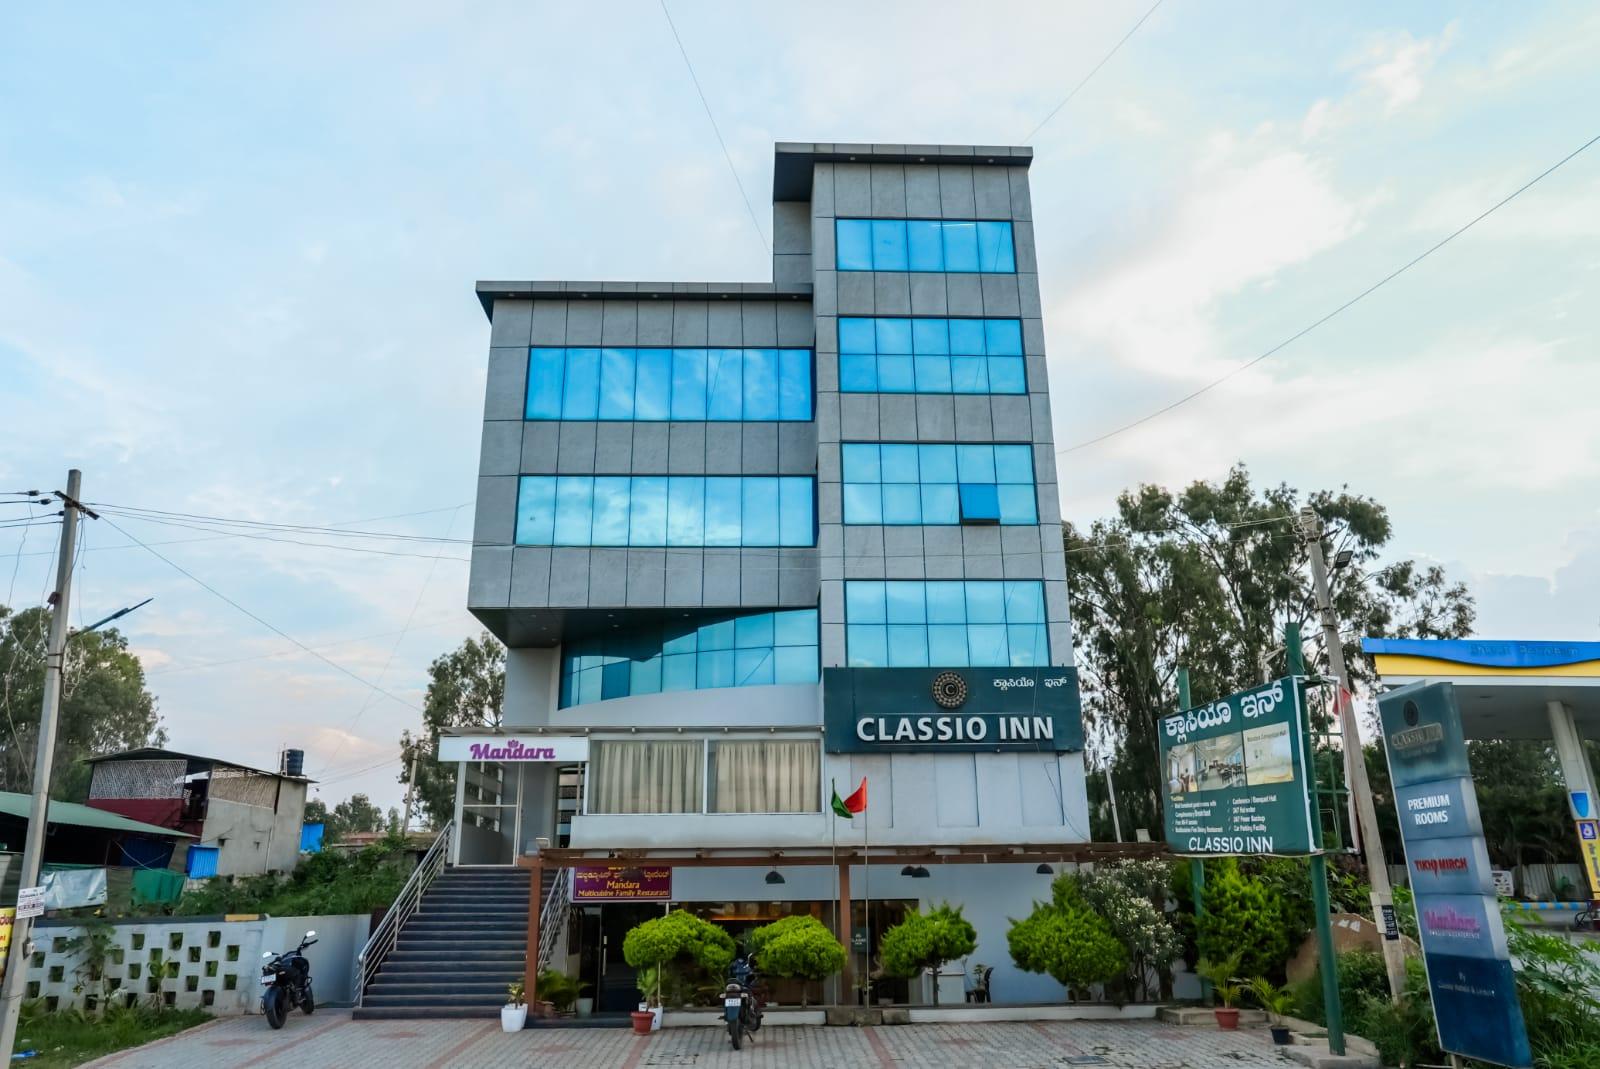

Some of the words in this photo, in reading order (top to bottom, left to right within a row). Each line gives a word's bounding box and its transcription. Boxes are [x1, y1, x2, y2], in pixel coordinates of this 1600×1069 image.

[1044, 676, 1068, 688] ಇನ್
[1240, 680, 1284, 718] ಇನ್
[856, 716, 987, 741] CLASSIO
[1000, 716, 1054, 740] INN
[470, 742, 556, 760] Mandara
[1407, 793, 1451, 811] PREMIUM
[1414, 810, 1449, 826] ROOMS
[1188, 836, 1243, 852] CLASSIO
[1247, 836, 1273, 852] INN
[606, 880, 640, 889] Mandara
[615, 889, 636, 898] Family
